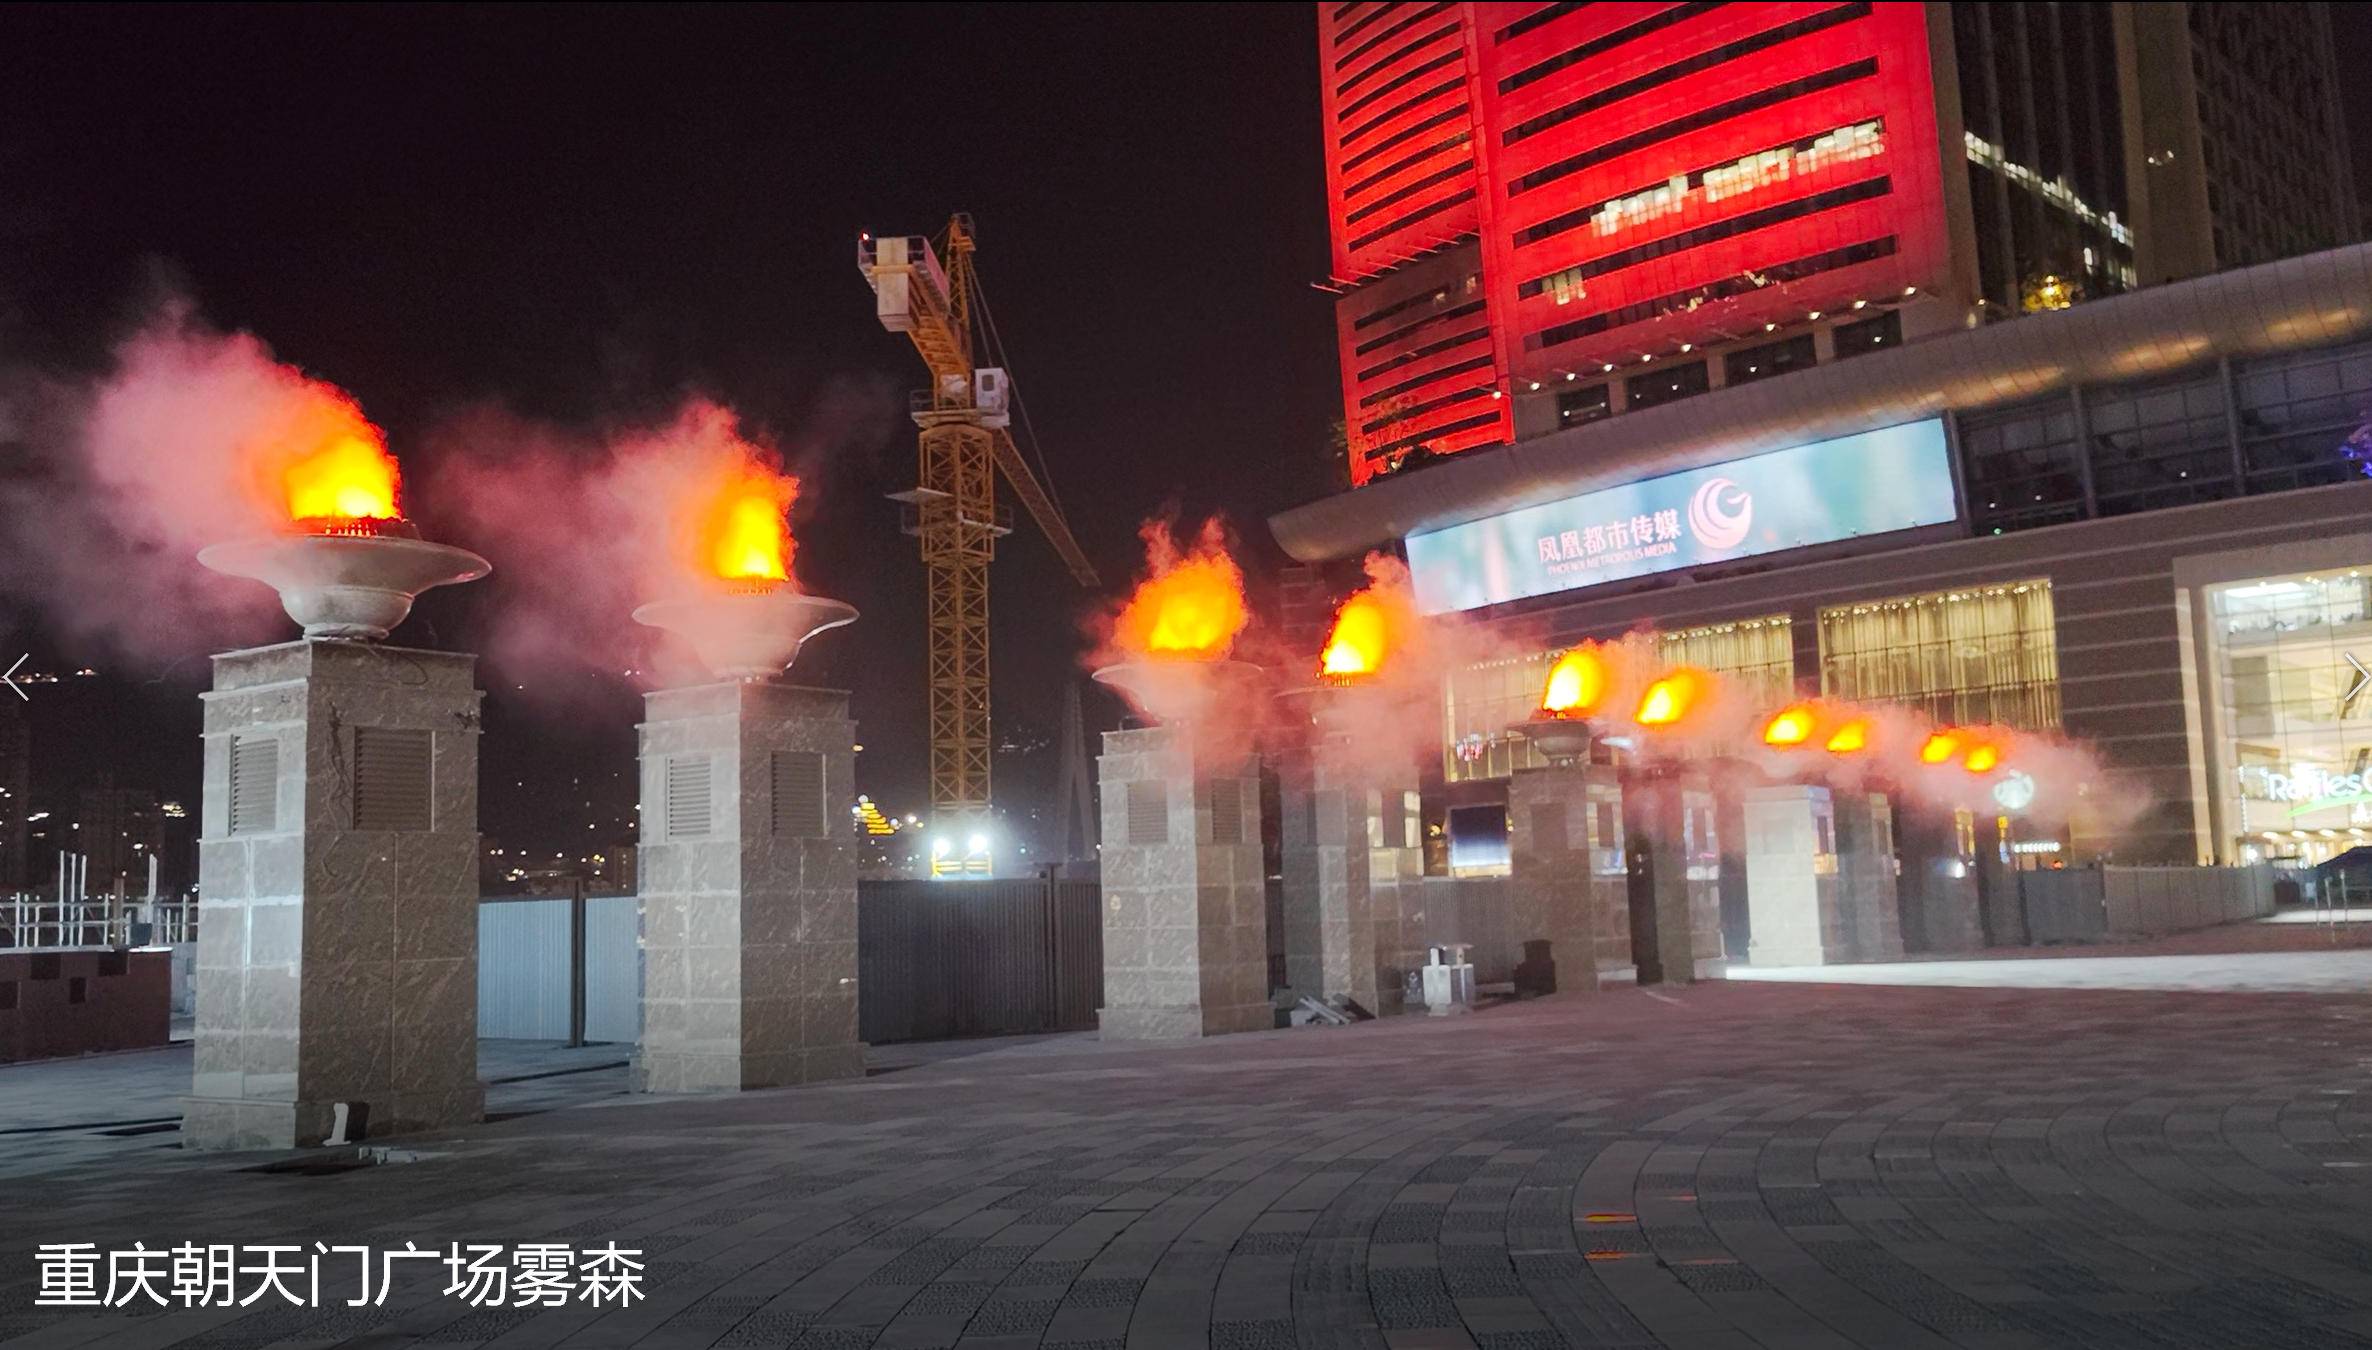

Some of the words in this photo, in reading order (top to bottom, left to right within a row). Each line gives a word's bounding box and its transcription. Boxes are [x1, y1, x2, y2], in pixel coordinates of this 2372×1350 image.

[1538, 509, 1682, 562] 凤凰都市传媒
[1644, 542, 1676, 557] MEDIA
